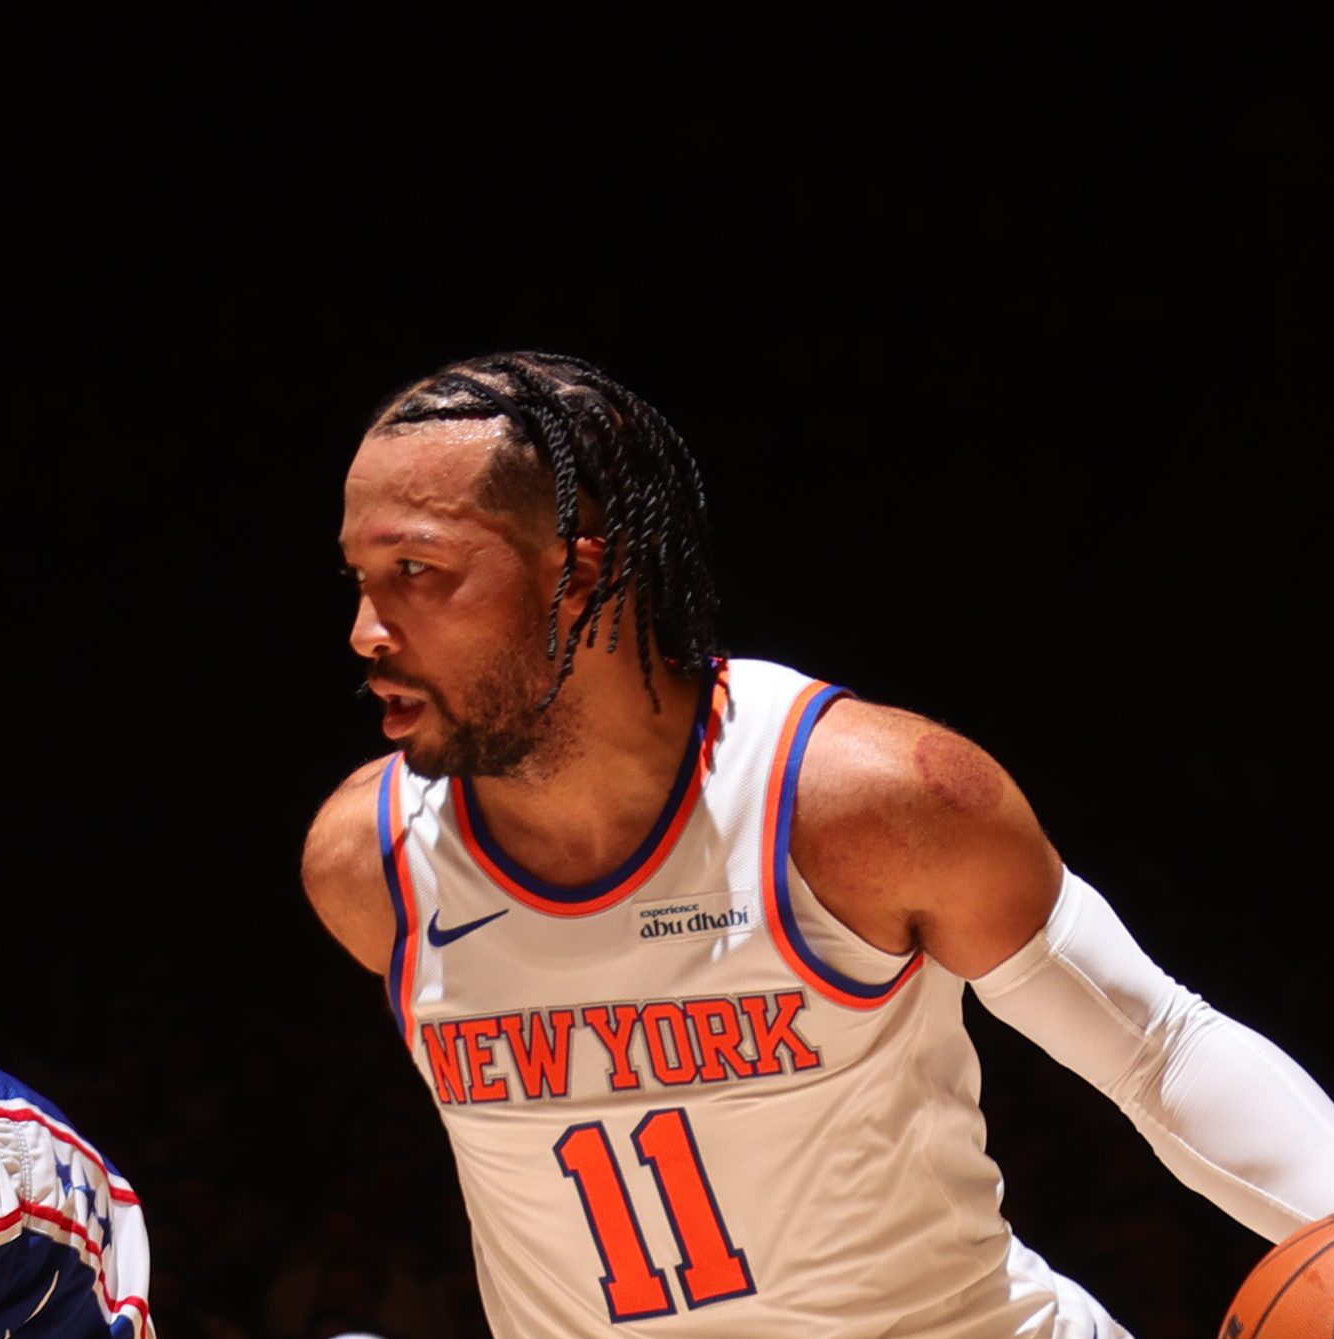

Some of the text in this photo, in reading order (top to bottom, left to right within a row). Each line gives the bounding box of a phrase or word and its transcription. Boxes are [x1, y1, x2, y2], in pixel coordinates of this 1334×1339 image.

[640, 903, 700, 918] experience
[640, 906, 749, 939] abu dhabi
[421, 991, 821, 1104] NEW YORK
[553, 1107, 757, 1324] 11
